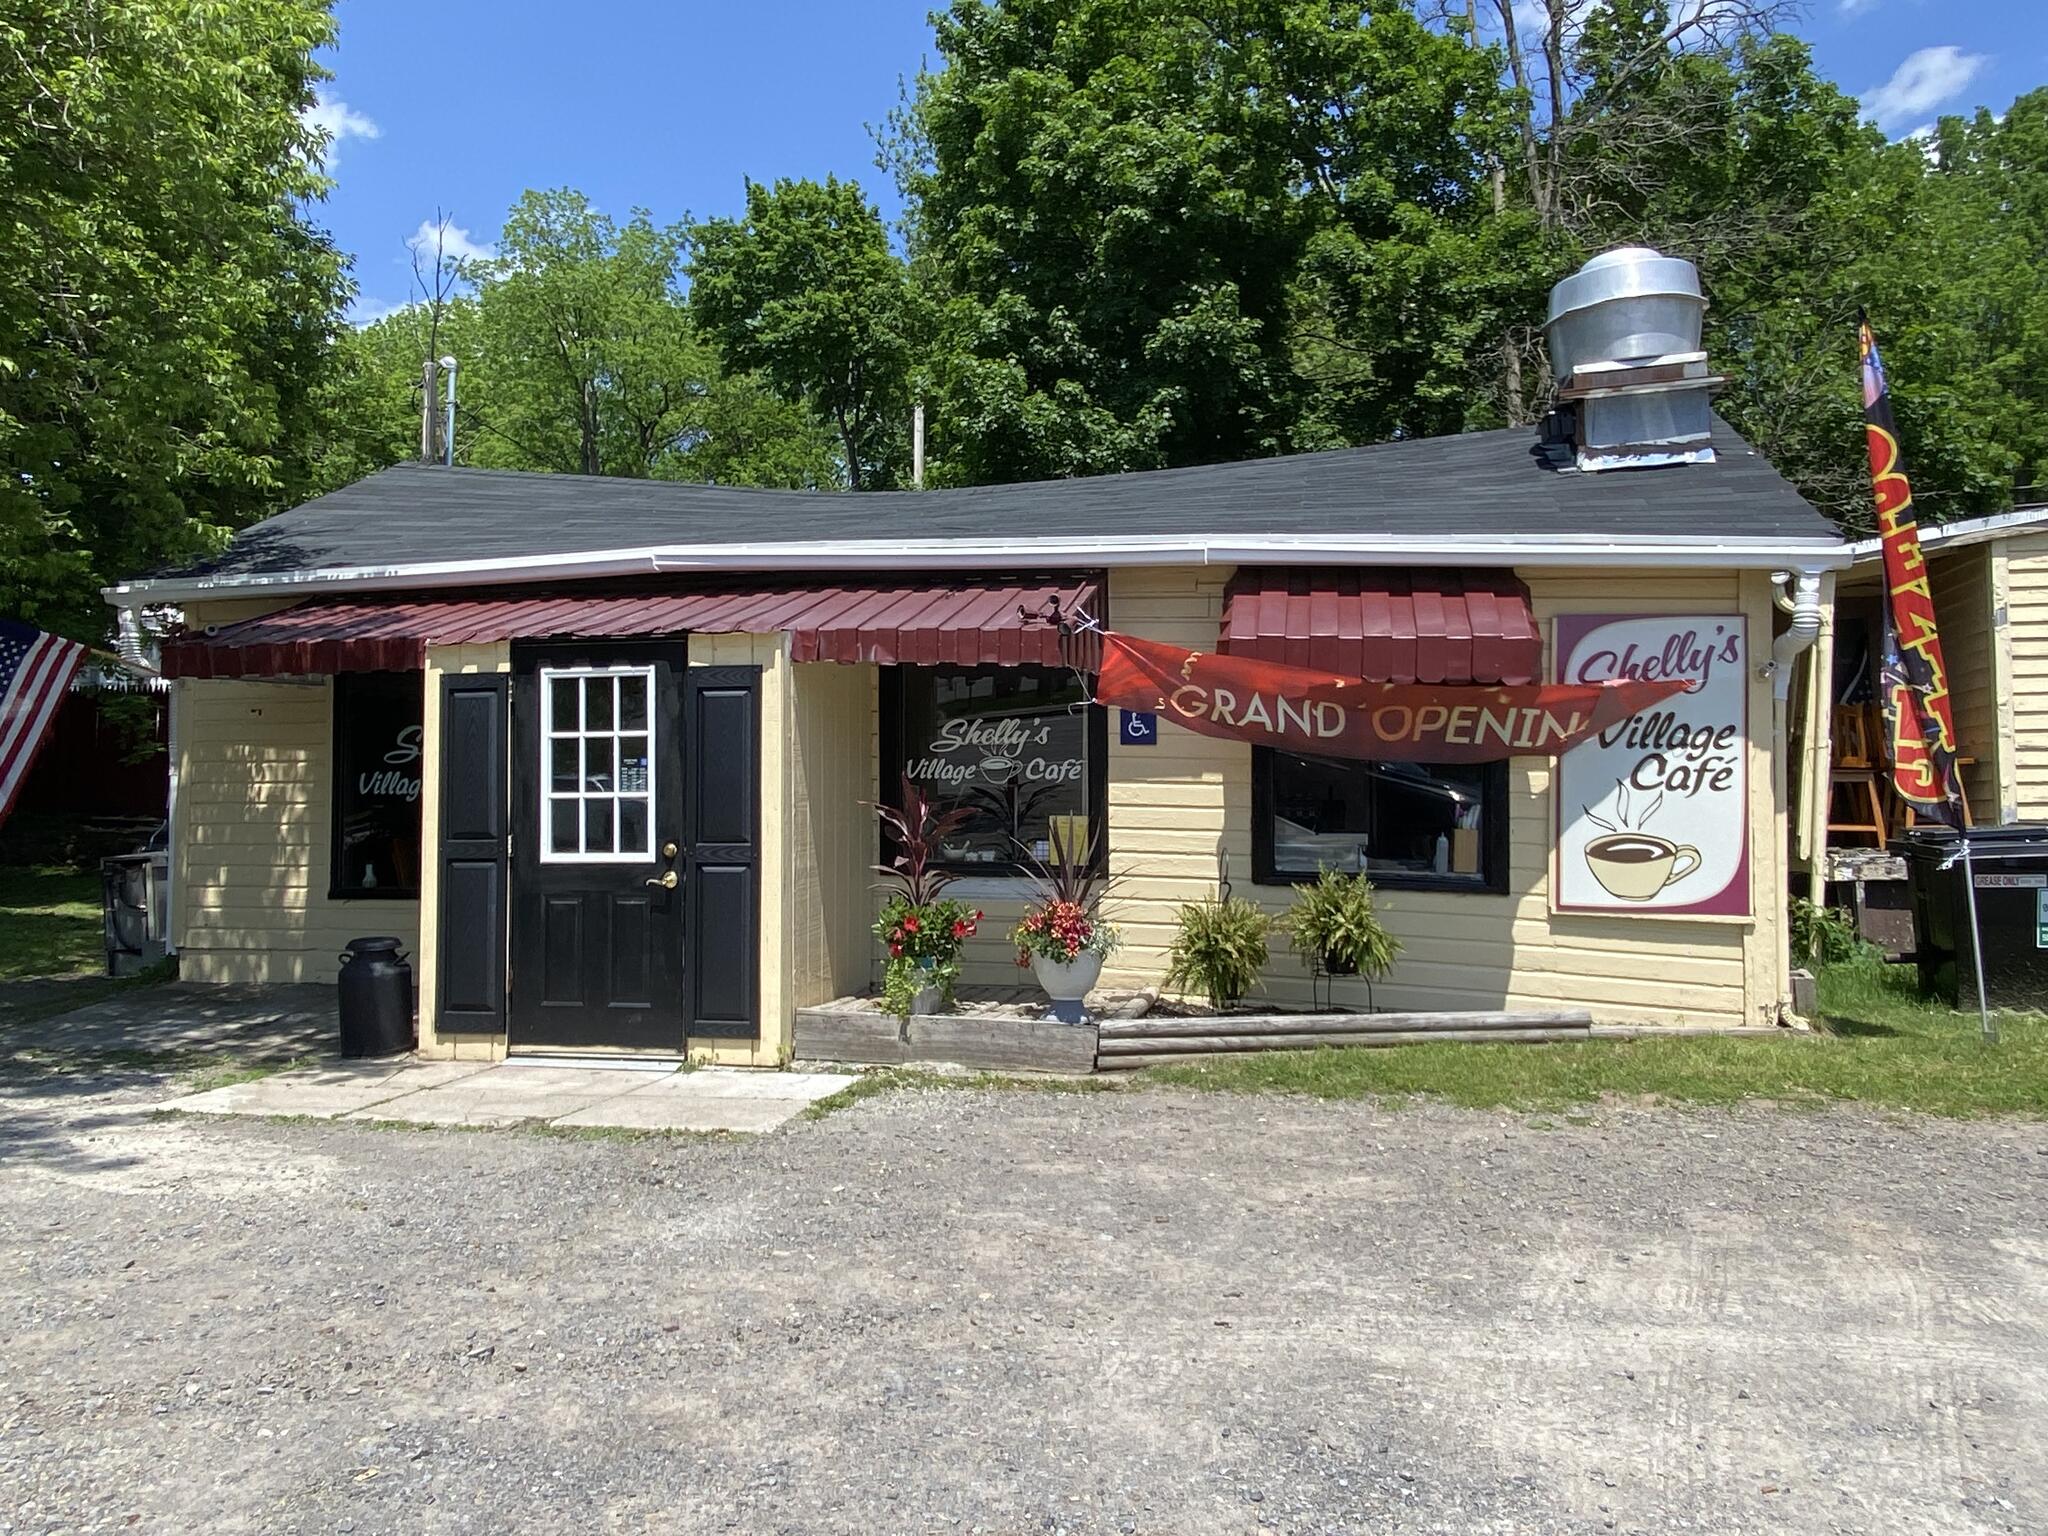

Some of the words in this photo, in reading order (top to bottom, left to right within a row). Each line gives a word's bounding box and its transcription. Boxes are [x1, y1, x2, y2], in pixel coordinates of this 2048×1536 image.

[1577, 625, 1741, 694] Shelly's
[929, 717, 1050, 758] Shelly's
[1170, 685, 1347, 738] GRAND
[1371, 704, 1590, 748] OPENIN
[1598, 711, 1737, 762] Village
[359, 770, 423, 802] Villag
[906, 757, 976, 785] Village
[1025, 757, 1083, 784] Café
[1629, 752, 1739, 799] Café
